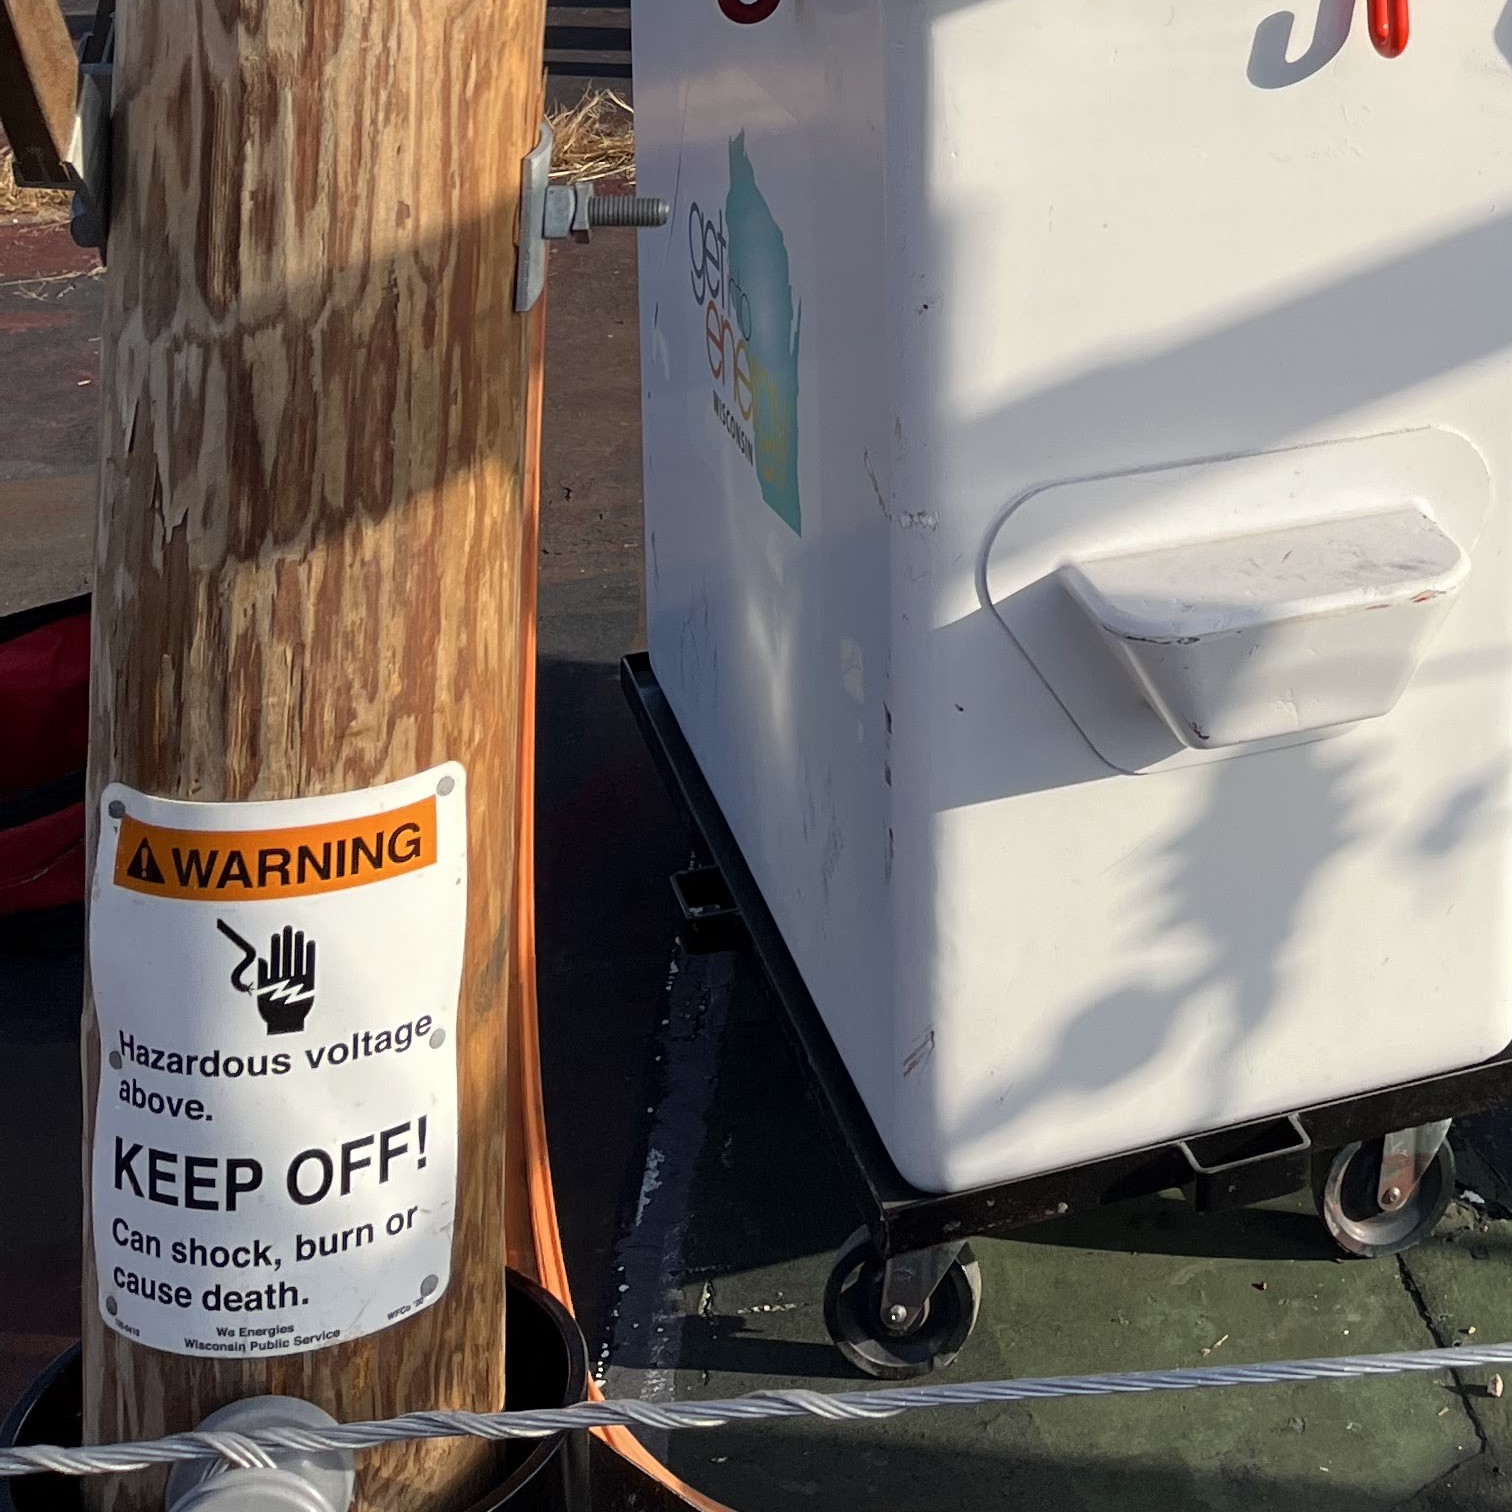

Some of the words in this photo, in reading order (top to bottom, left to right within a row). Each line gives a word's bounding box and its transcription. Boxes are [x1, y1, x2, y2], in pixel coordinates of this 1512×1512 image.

[712, 389, 755, 468] WISCONSIN
[171, 821, 422, 890] WARNING
[118, 1028, 293, 1078] Hazardous
[304, 1011, 433, 1070] voltage
[118, 1076, 213, 1123] above.
[113, 1135, 264, 1212] KEEP
[286, 1114, 429, 1207] OFF!
[111, 1217, 162, 1259] Can
[170, 1233, 283, 1271] shock,
[294, 1222, 374, 1264] burn
[384, 1204, 419, 1236] or
[112, 1265, 192, 1309] cause
[201, 1281, 309, 1312] death.
[184, 1337, 246, 1354] Wisconsin
[250, 1338, 290, 1352] Public
[293, 1328, 341, 1347] Service
[215, 1326, 236, 1337] We
[238, 1324, 295, 1337] Energies
